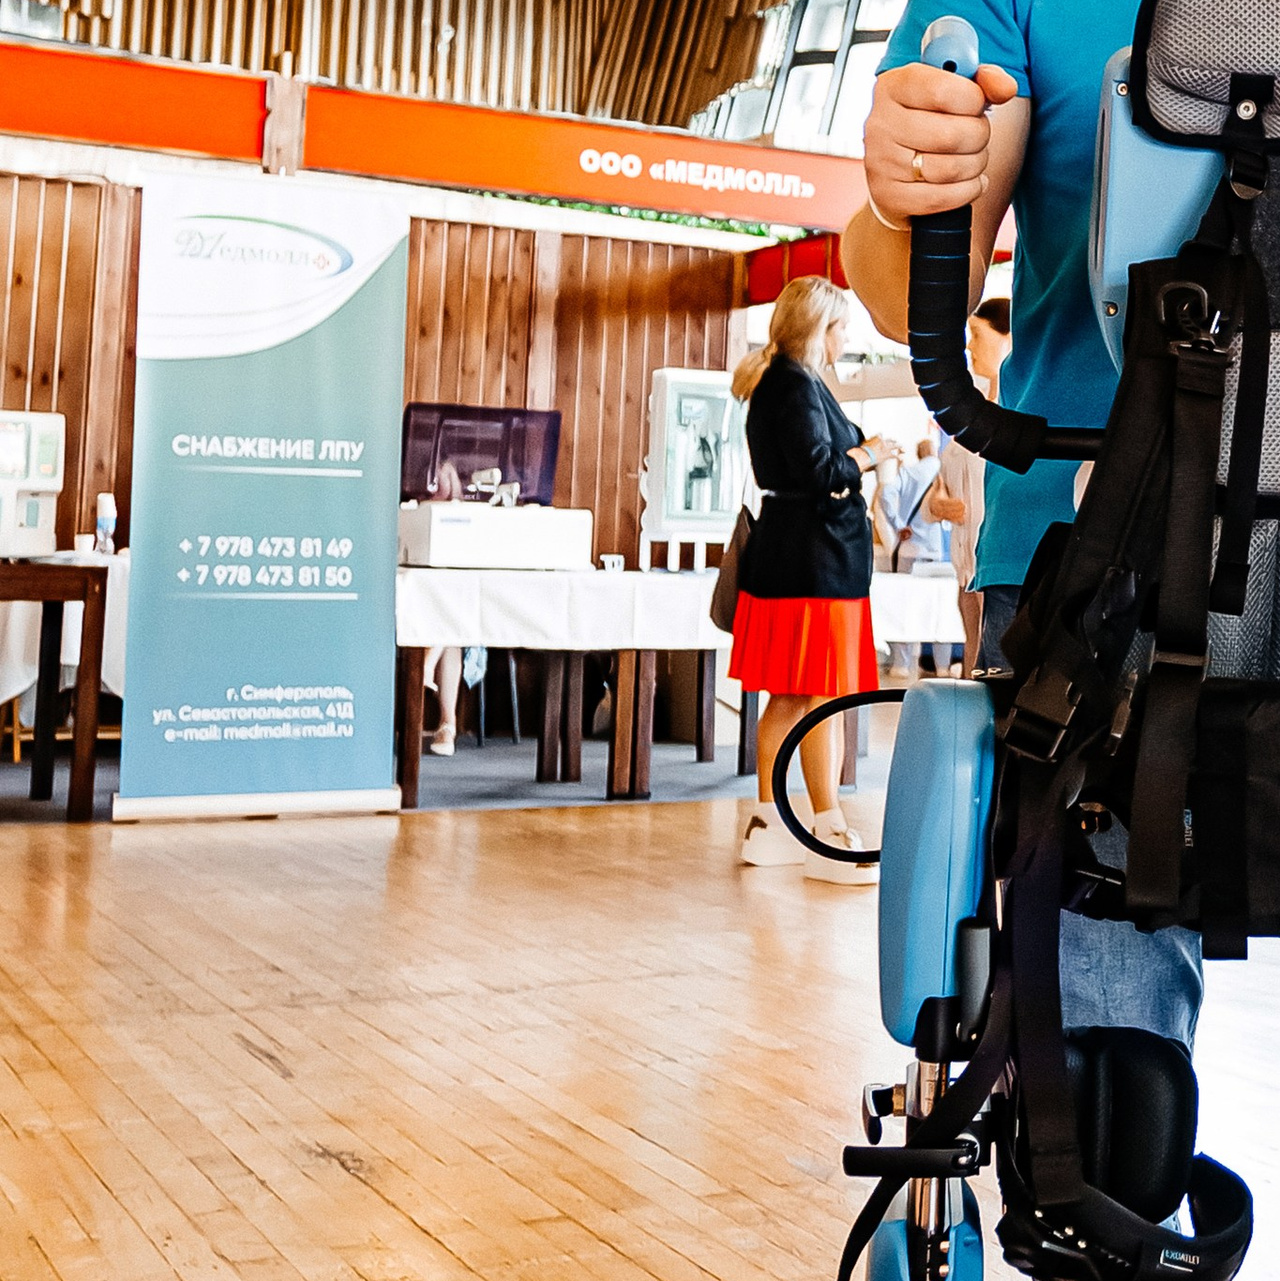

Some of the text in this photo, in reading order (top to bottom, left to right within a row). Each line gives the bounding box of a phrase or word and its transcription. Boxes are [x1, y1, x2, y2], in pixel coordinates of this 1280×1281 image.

[579, 149, 815, 198] ООО «МЕДМОЛЛ»
[171, 434, 364, 462] СНАБЖЕНИЕ ЛПУ
[197, 535, 211, 557] 7
[215, 536, 253, 557] 978
[257, 537, 296, 558] 473
[300, 537, 322, 558] 81
[326, 538, 353, 558] 49
[195, 565, 209, 586] 7
[213, 565, 252, 586] 978
[255, 565, 294, 587] 473
[298, 565, 320, 587] 81
[325, 566, 352, 587] 50
